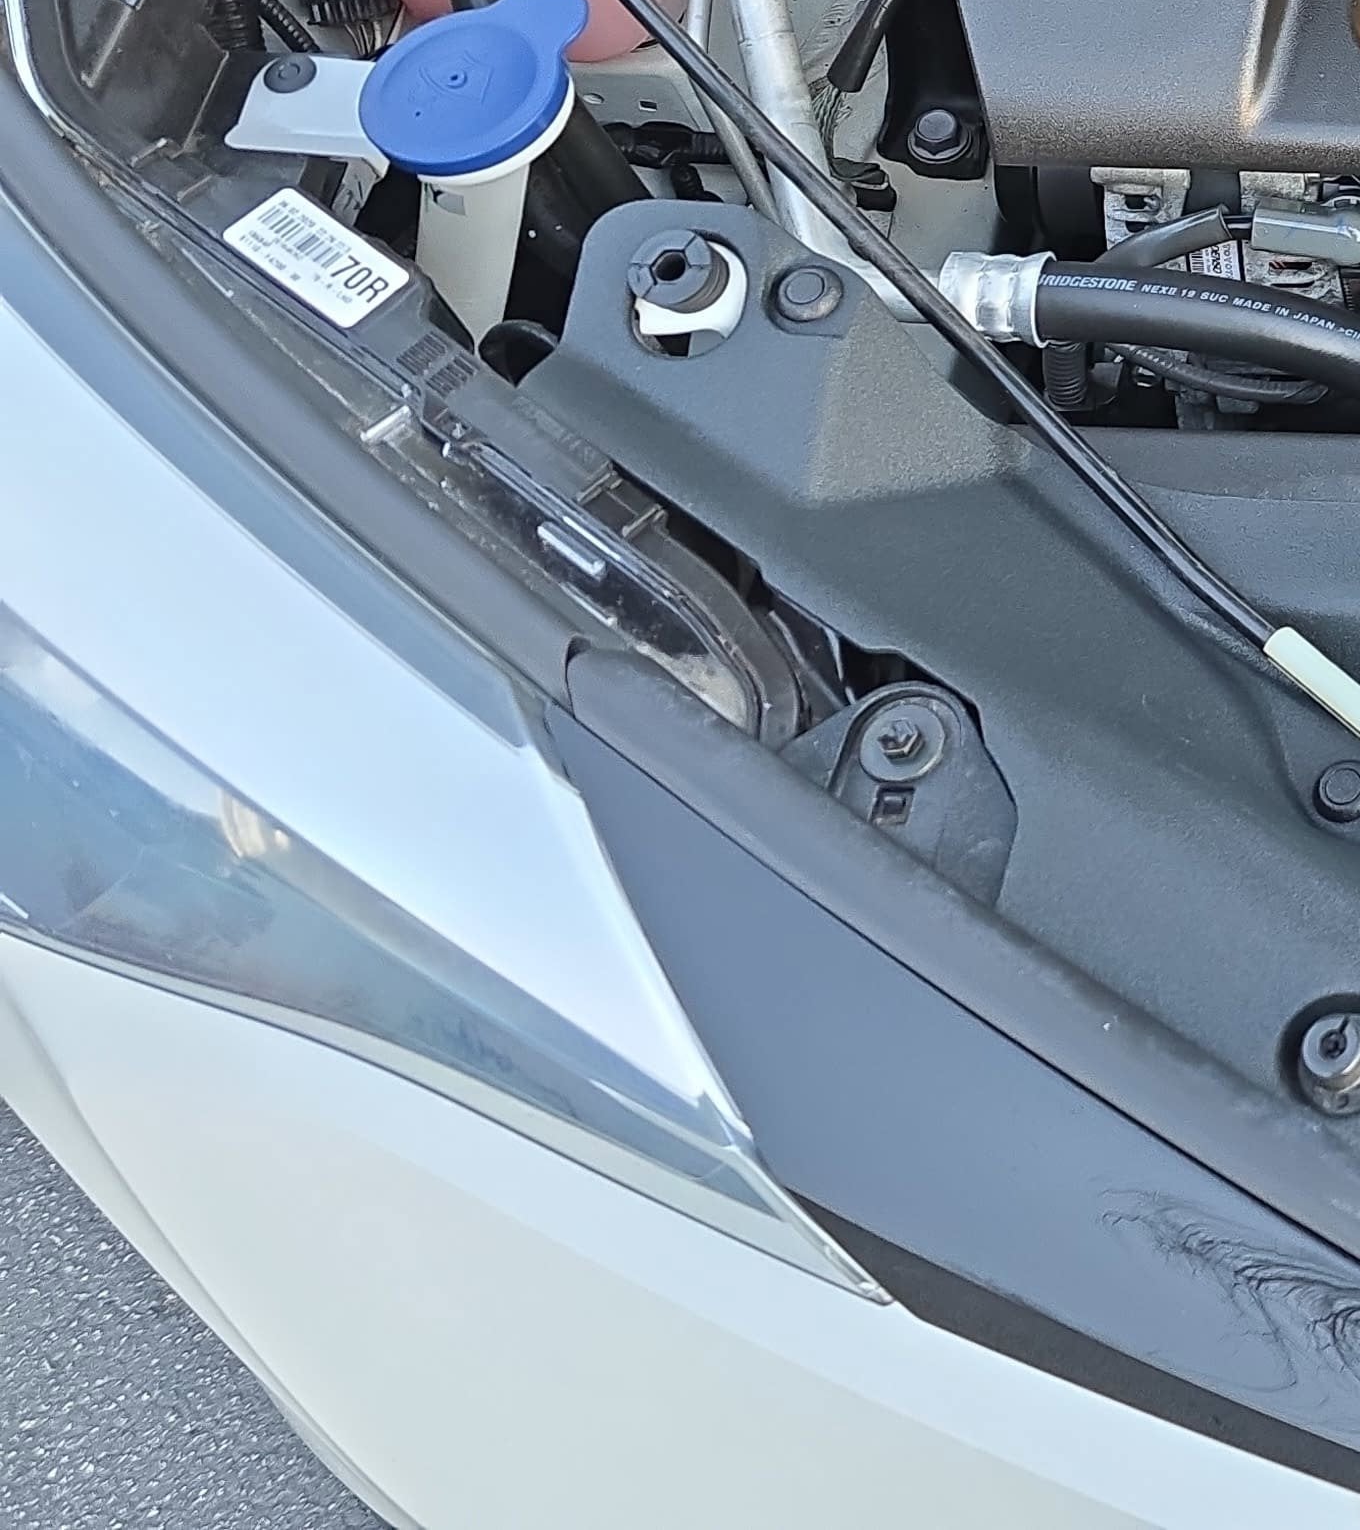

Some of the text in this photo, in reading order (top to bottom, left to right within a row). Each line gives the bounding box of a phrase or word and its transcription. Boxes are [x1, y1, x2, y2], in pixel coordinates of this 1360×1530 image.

[330, 255, 389, 303] 70R
[1232, 297, 1271, 312] MADE
[1275, 306, 1290, 317] IN
[1293, 311, 1336, 331] JAPAN
